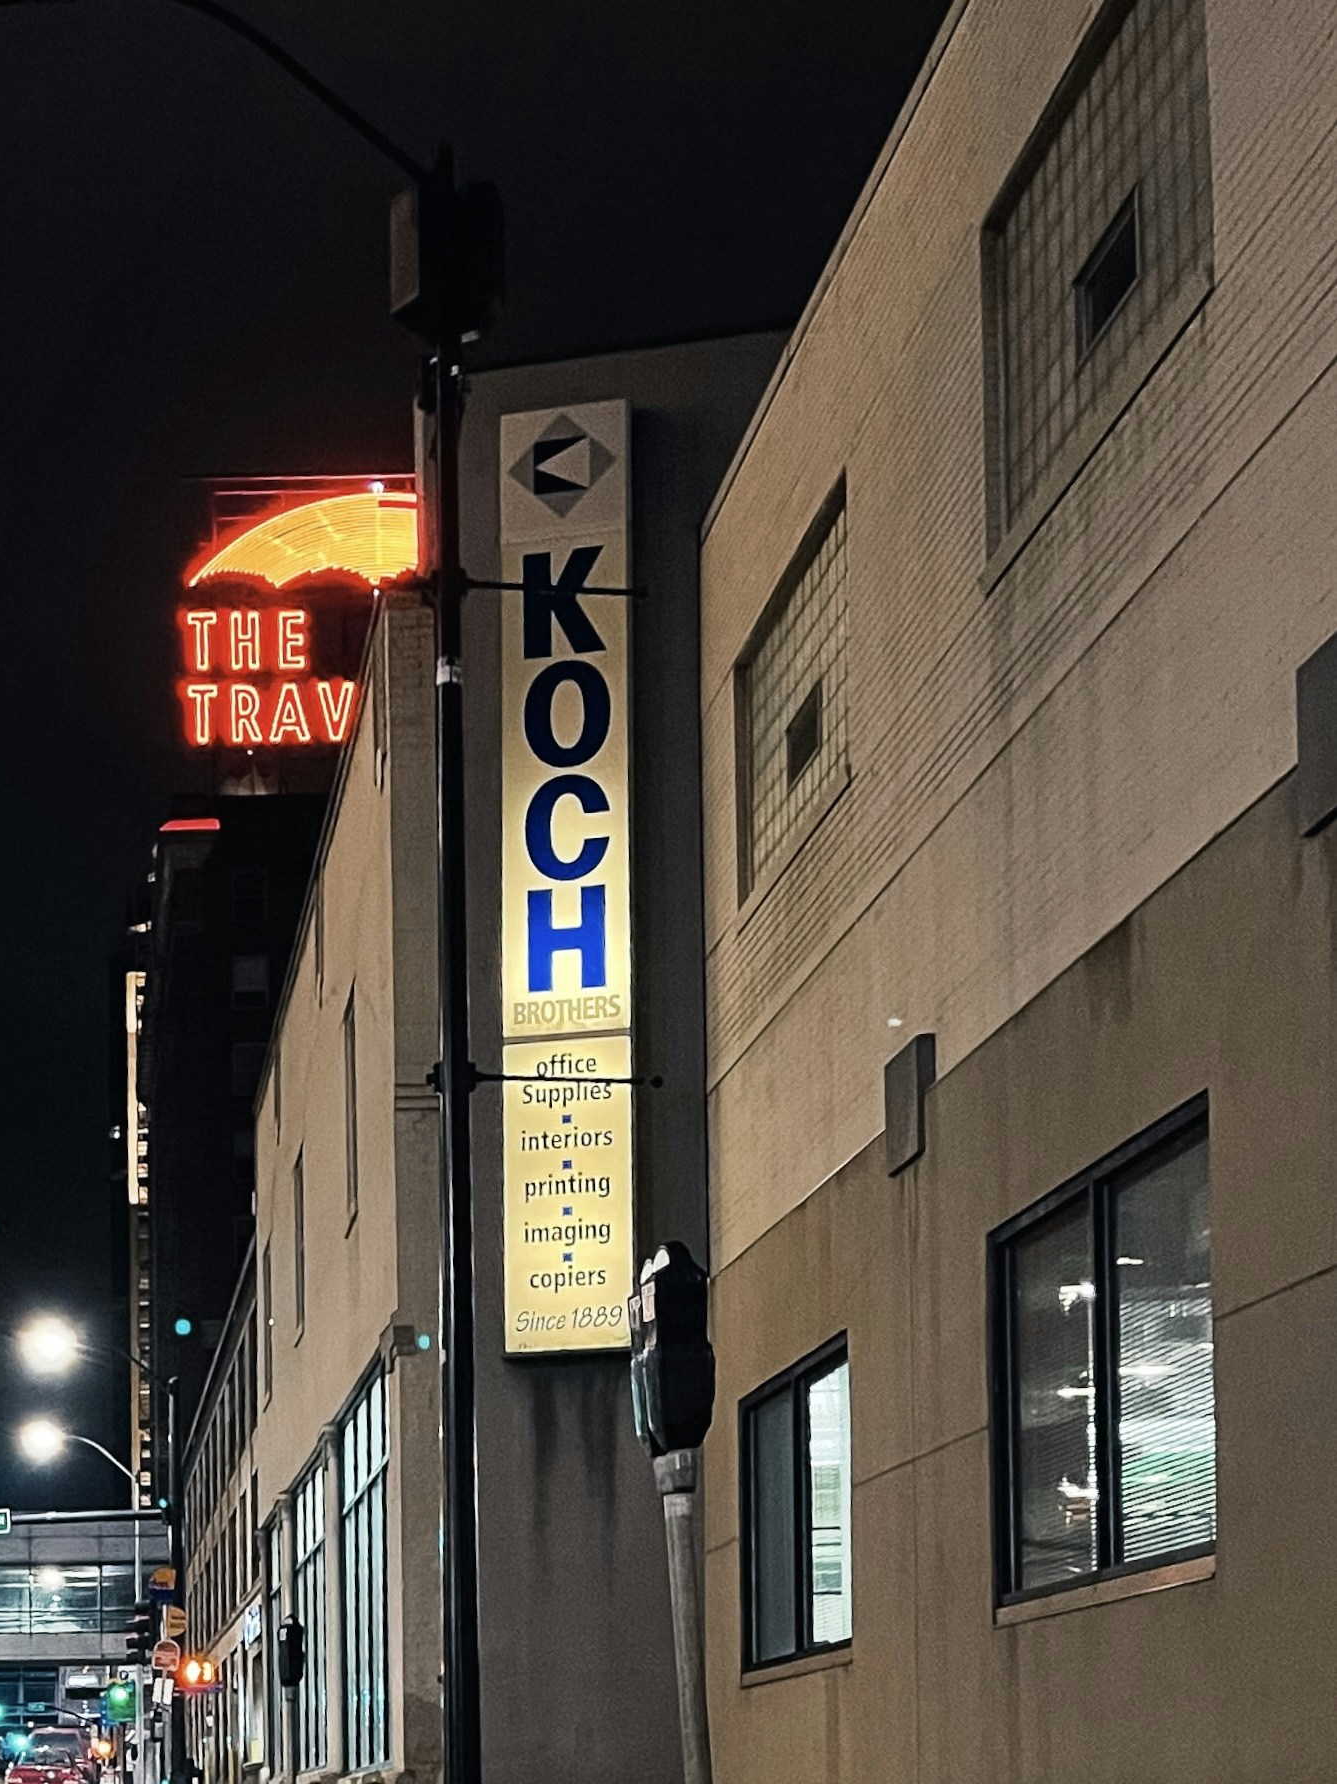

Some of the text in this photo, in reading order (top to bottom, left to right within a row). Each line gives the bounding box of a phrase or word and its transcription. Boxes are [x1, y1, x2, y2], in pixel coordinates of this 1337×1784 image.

[187, 610, 307, 671] THE
[187, 682, 356, 745] TRAV
[522, 544, 612, 993] KOCH
[513, 994, 621, 1025] BROTHERS
[536, 1053, 597, 1078] office
[522, 1081, 613, 1108] Supplies
[520, 1127, 614, 1152] interiors
[524, 1174, 611, 1203] printing
[524, 1219, 611, 1247] imaging
[529, 1265, 607, 1293] copiers
[516, 1304, 623, 1333] Since 1889
